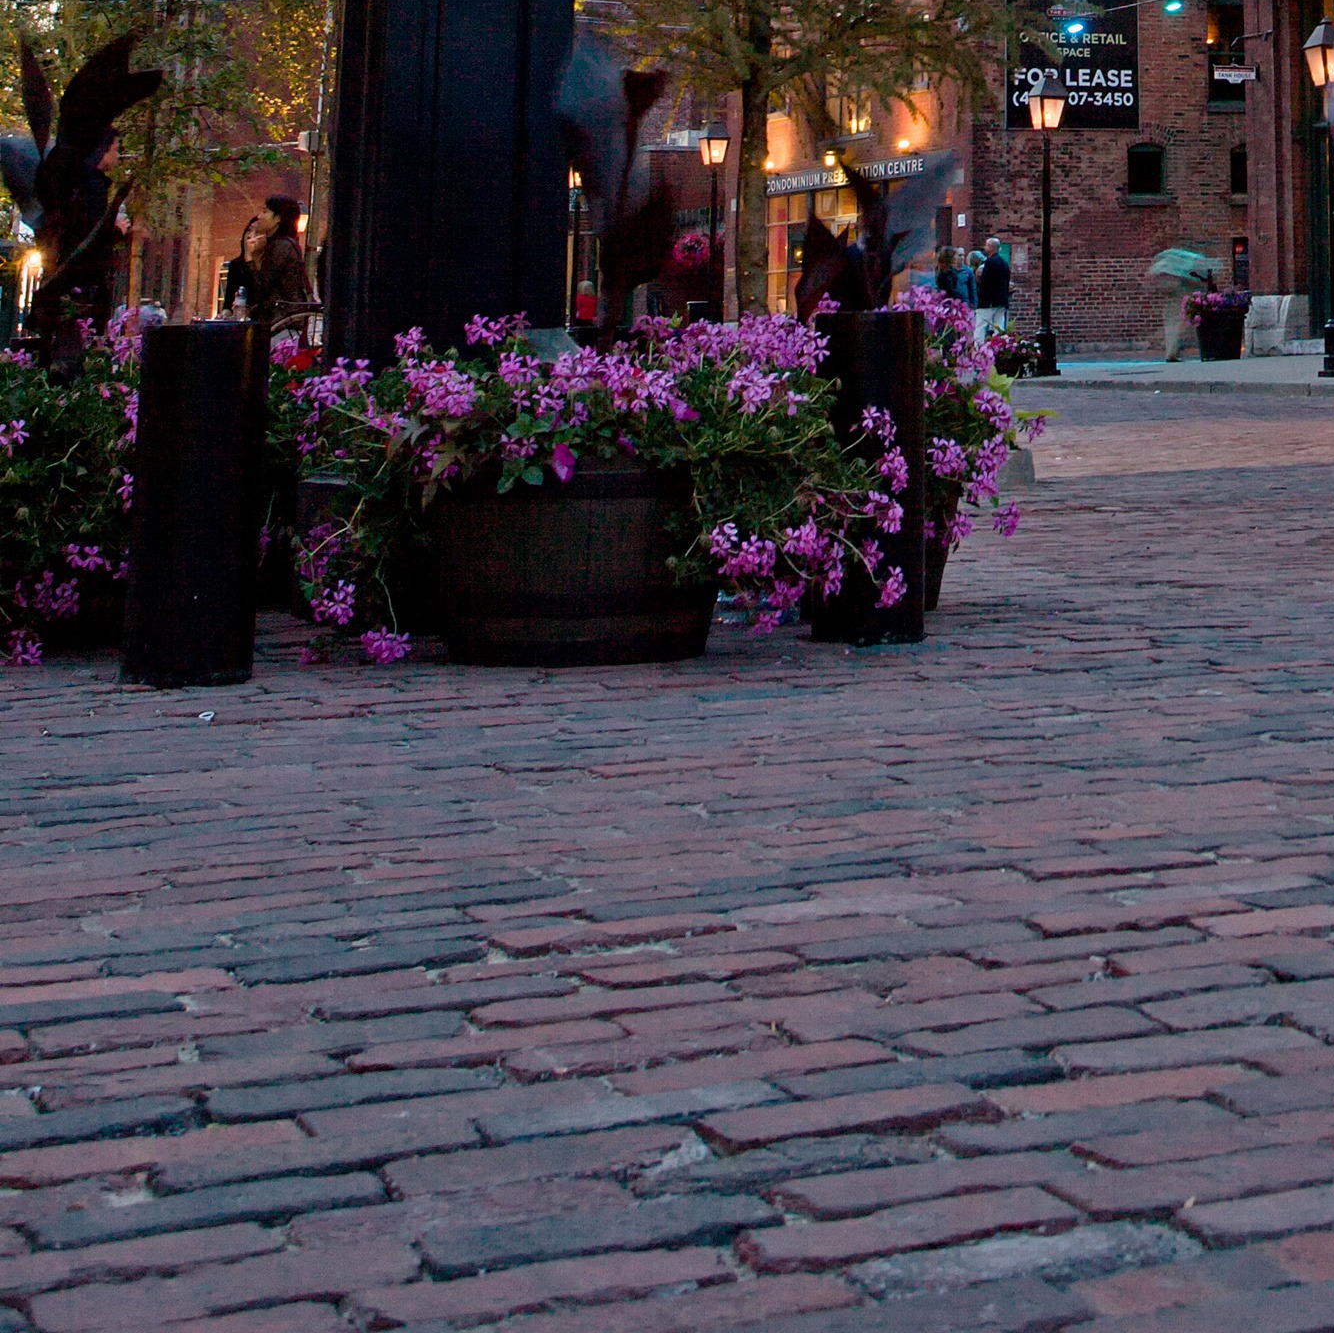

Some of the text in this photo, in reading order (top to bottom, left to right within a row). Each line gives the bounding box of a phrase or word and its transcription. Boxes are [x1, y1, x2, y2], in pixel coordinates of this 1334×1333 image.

[1069, 34, 1079, 44] &
[1082, 33, 1127, 45] RETAIL
[1065, 68, 1133, 87] LEASE
[887, 159, 924, 176] CENTRE
